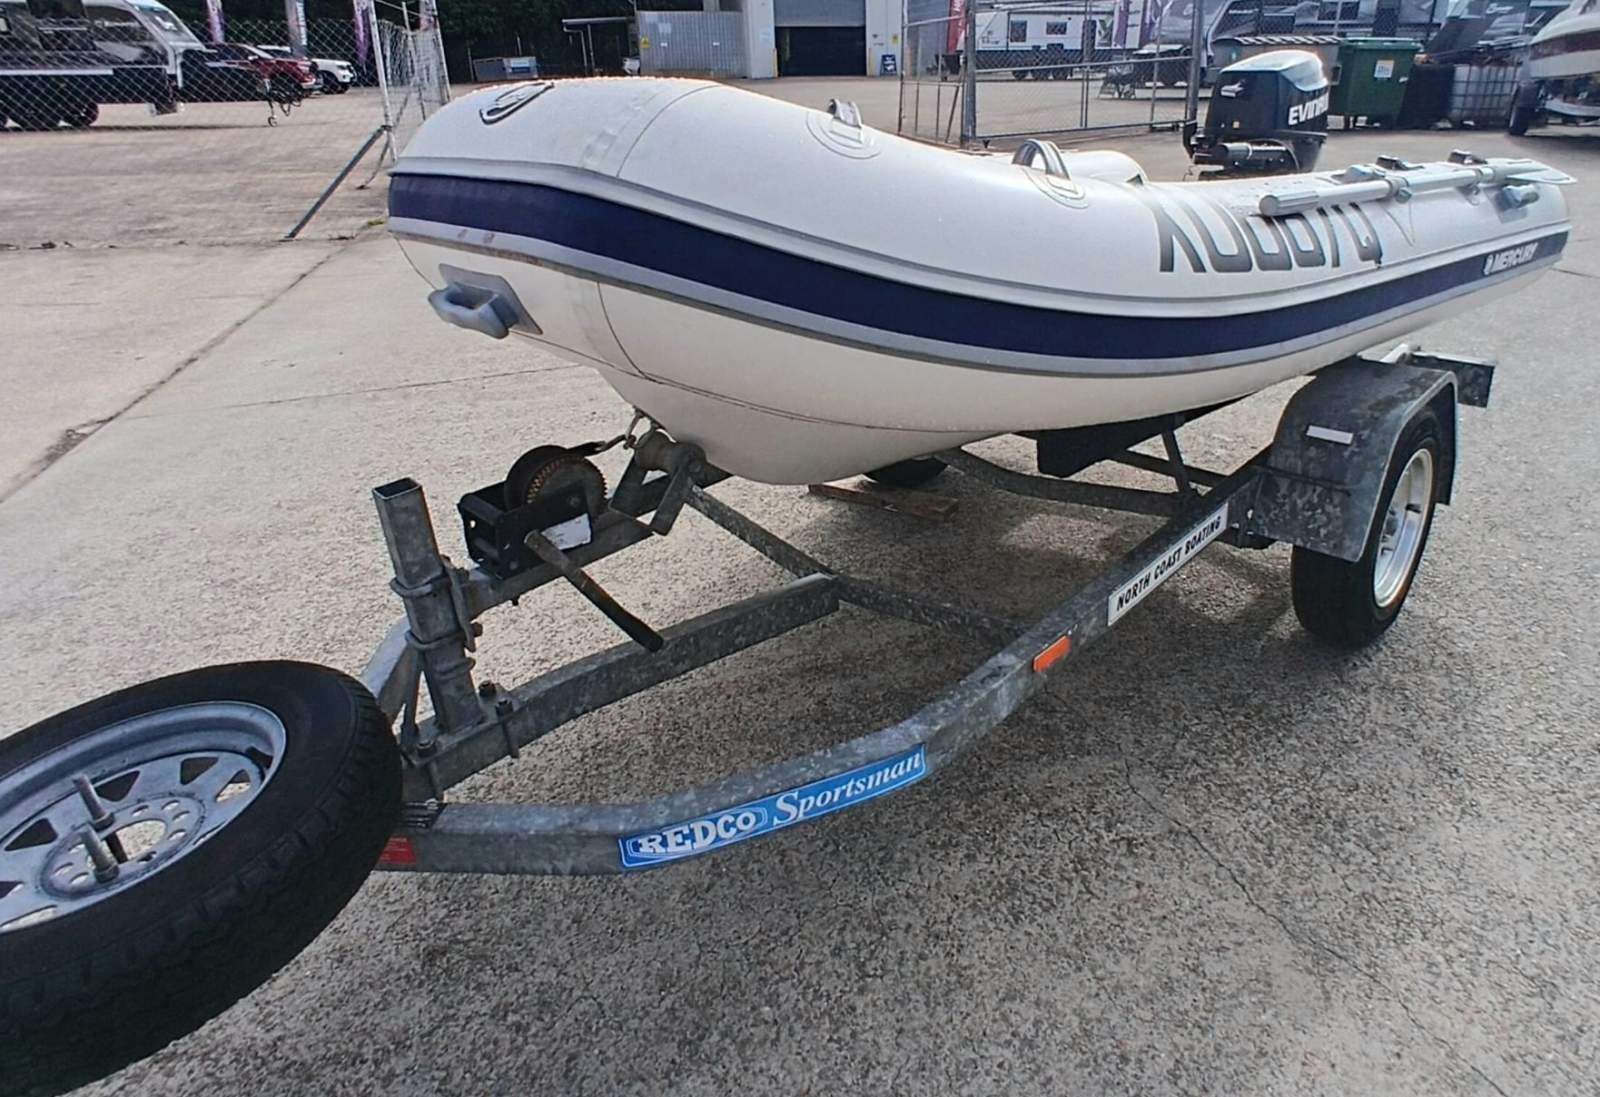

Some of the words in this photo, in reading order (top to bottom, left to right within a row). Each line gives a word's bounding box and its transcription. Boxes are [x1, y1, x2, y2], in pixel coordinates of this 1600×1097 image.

[1490, 241, 1539, 273] MERCURY
[1116, 572, 1151, 611] NORTH
[1153, 547, 1182, 580] COAST
[1184, 515, 1222, 555] BOATING
[638, 811, 756, 853] REDCO
[773, 752, 921, 826] Sportsman
